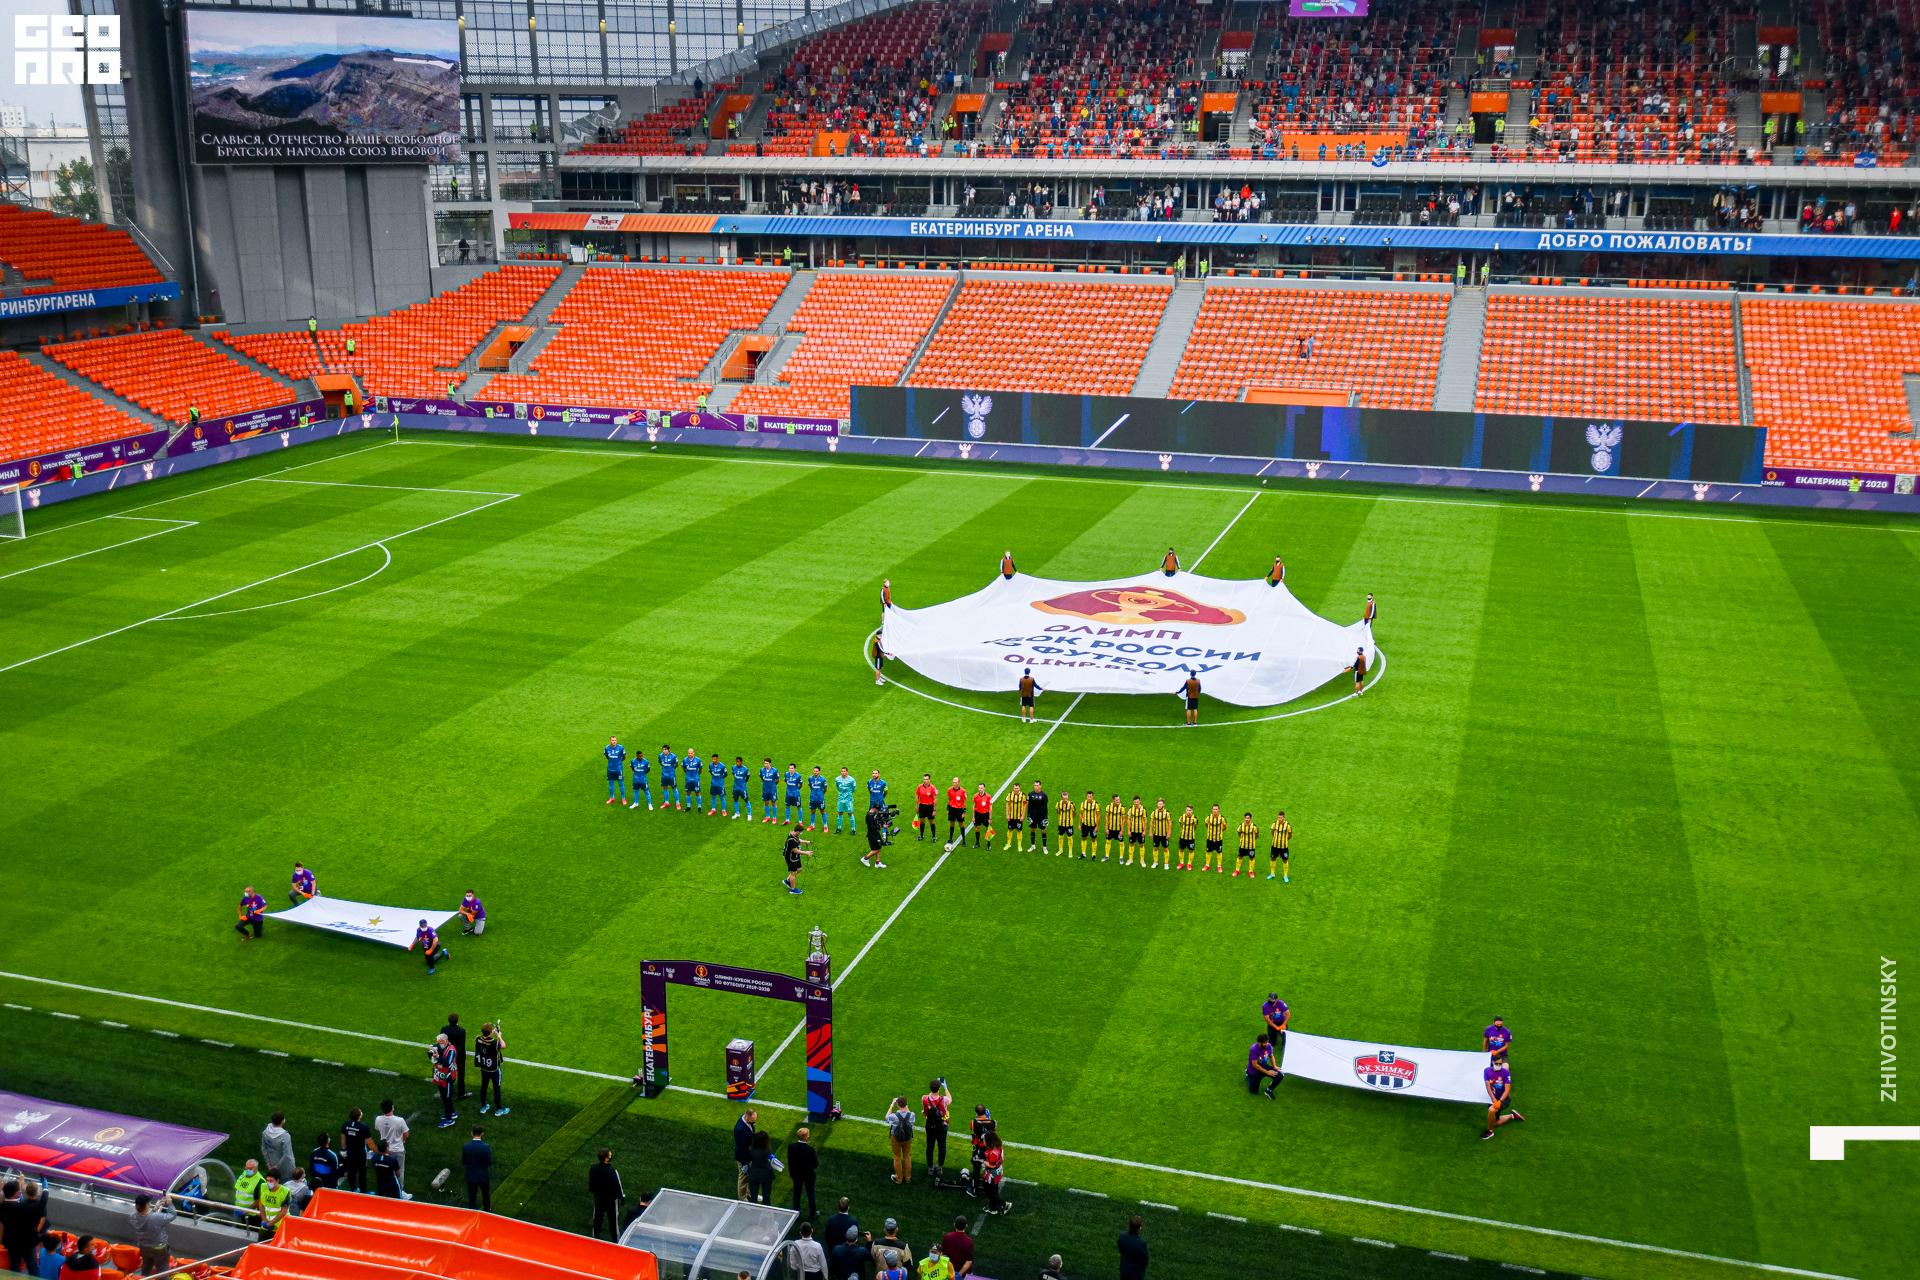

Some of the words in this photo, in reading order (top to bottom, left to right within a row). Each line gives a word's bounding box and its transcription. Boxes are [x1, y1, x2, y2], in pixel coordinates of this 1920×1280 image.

[346, 135, 382, 145] НАШЕ
[385, 135, 458, 145] СВОБОДНОЕ
[217, 145, 283, 157] БРАТСКИХ
[286, 146, 346, 157] НАРОДОВ
[349, 146, 387, 156] СОЮЗ
[910, 221, 1021, 236] ЕКАТЕРИНБУРГ
[1024, 223, 1075, 238] АРЕНА
[1537, 233, 1604, 250] ДОБРО
[1609, 235, 1753, 251] ПОЖАЛОВАТЬ!
[764, 421, 815, 432] ЕКАТЕРНБУРГ
[815, 424, 832, 432] 2020
[1865, 480, 1888, 488] 2020
[1043, 624, 1182, 640] ОЛИМП
[1031, 645, 1225, 674] ФУТБОЛУ
[1090, 640, 1262, 662] РОССИИ
[643, 1005, 655, 1082] ЕКАТЕРИНБУРГ
[56, 1135, 131, 1157] OLIMP.BET
